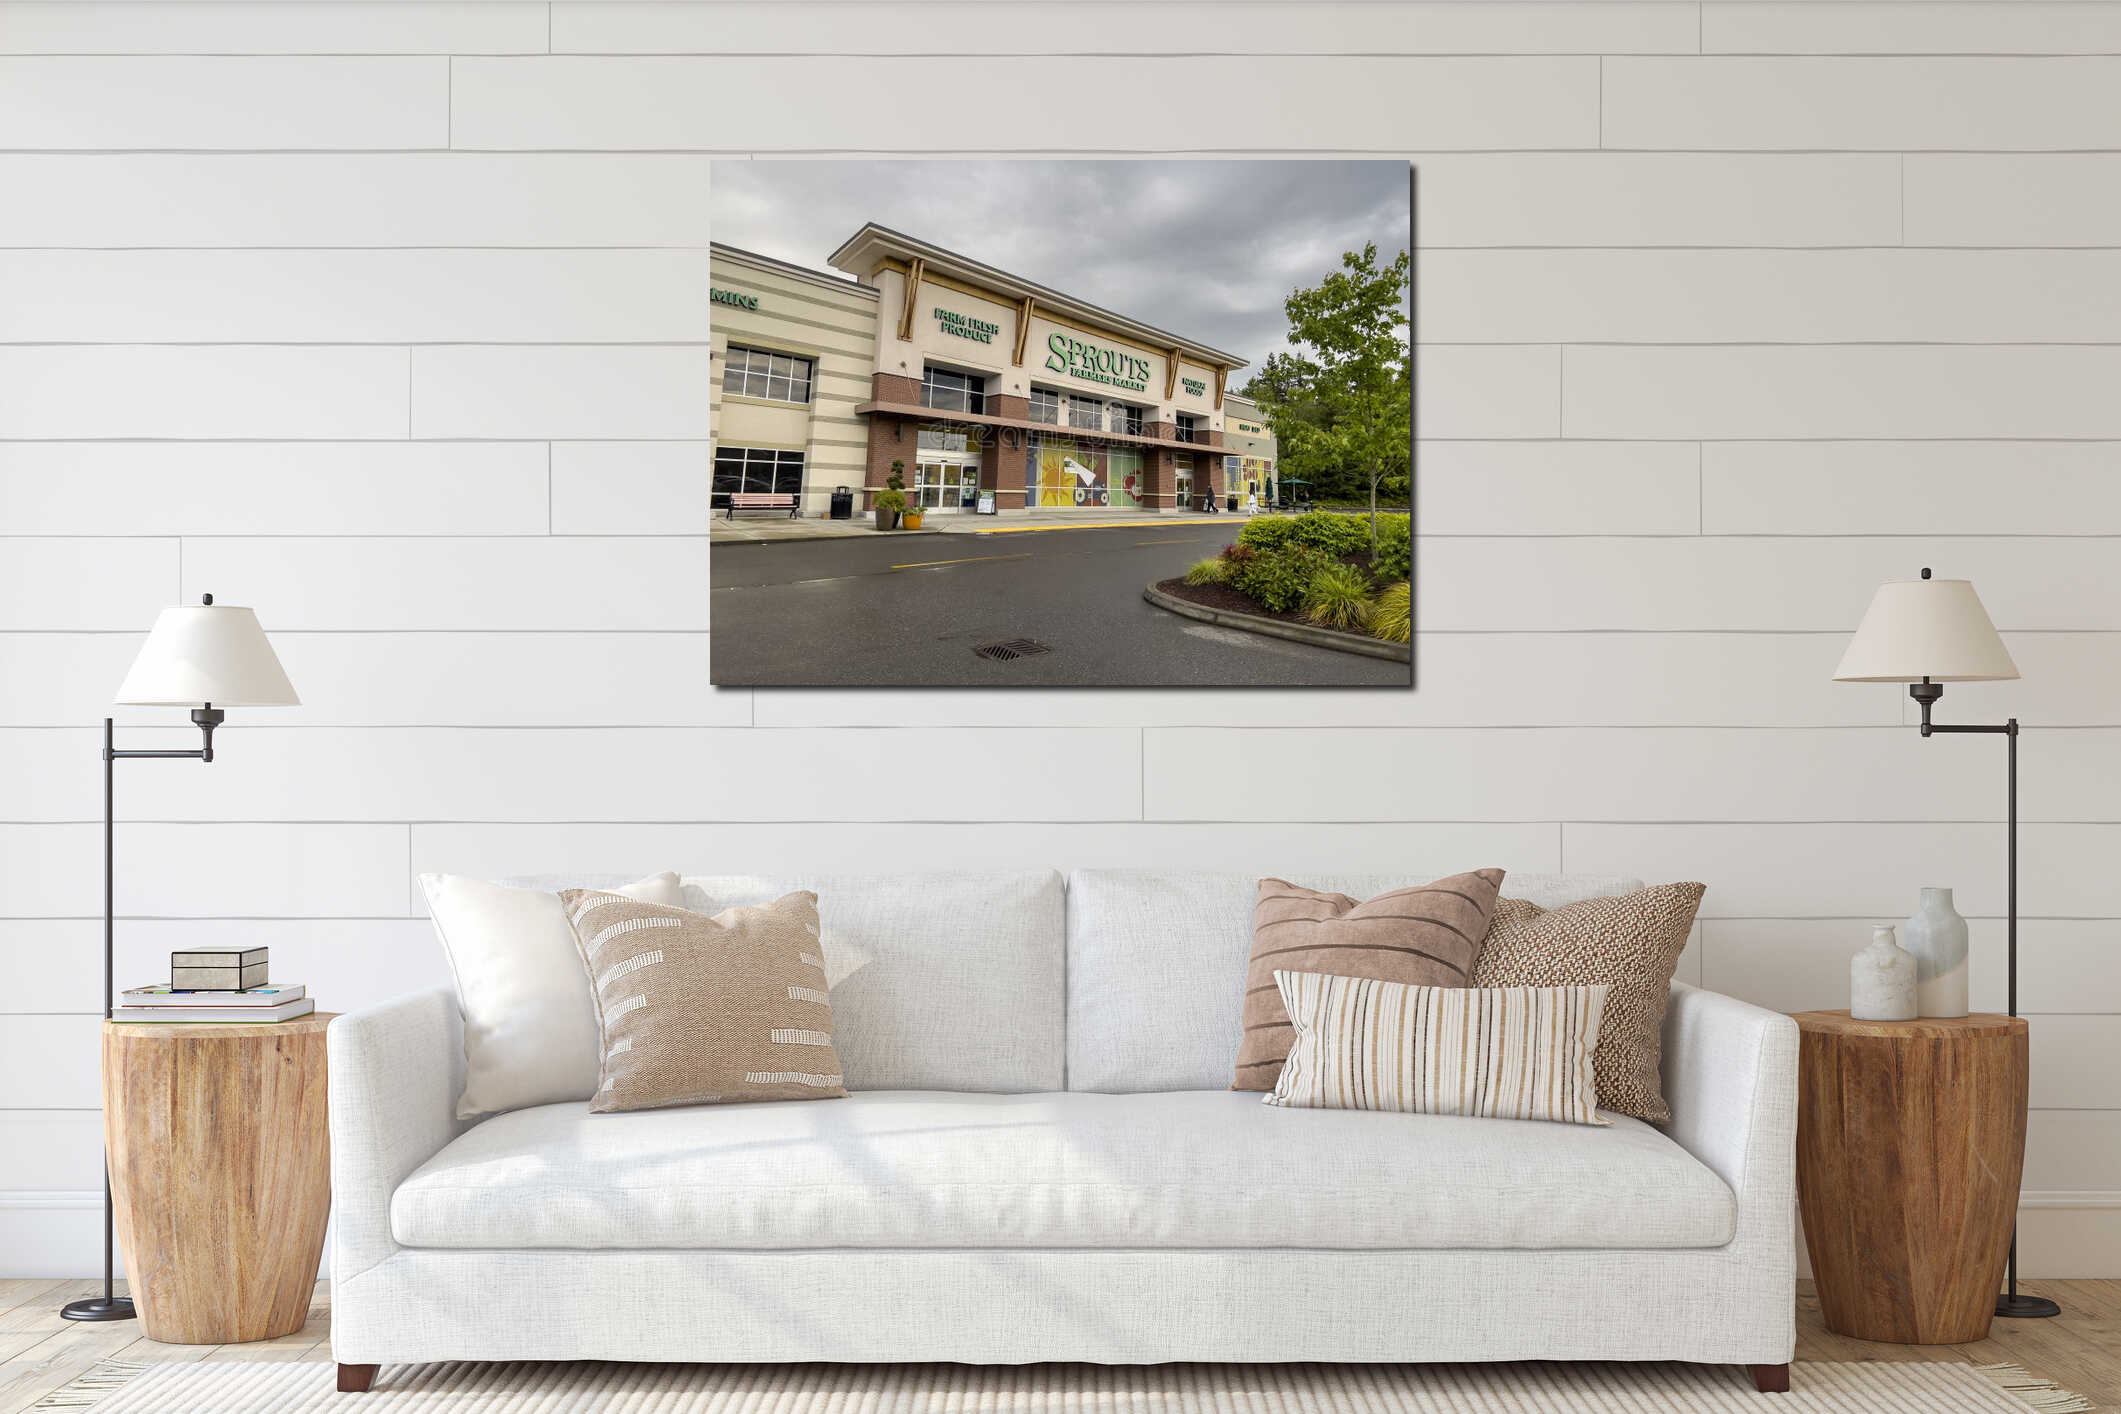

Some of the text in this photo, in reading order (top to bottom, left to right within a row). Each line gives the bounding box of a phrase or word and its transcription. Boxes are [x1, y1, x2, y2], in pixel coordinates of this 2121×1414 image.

[934, 307, 1000, 336] FARM FRESH
[941, 321, 993, 345] PRODUCE
[1045, 333, 1153, 382] SPROUTS
[1112, 377, 1147, 393] MARKET
